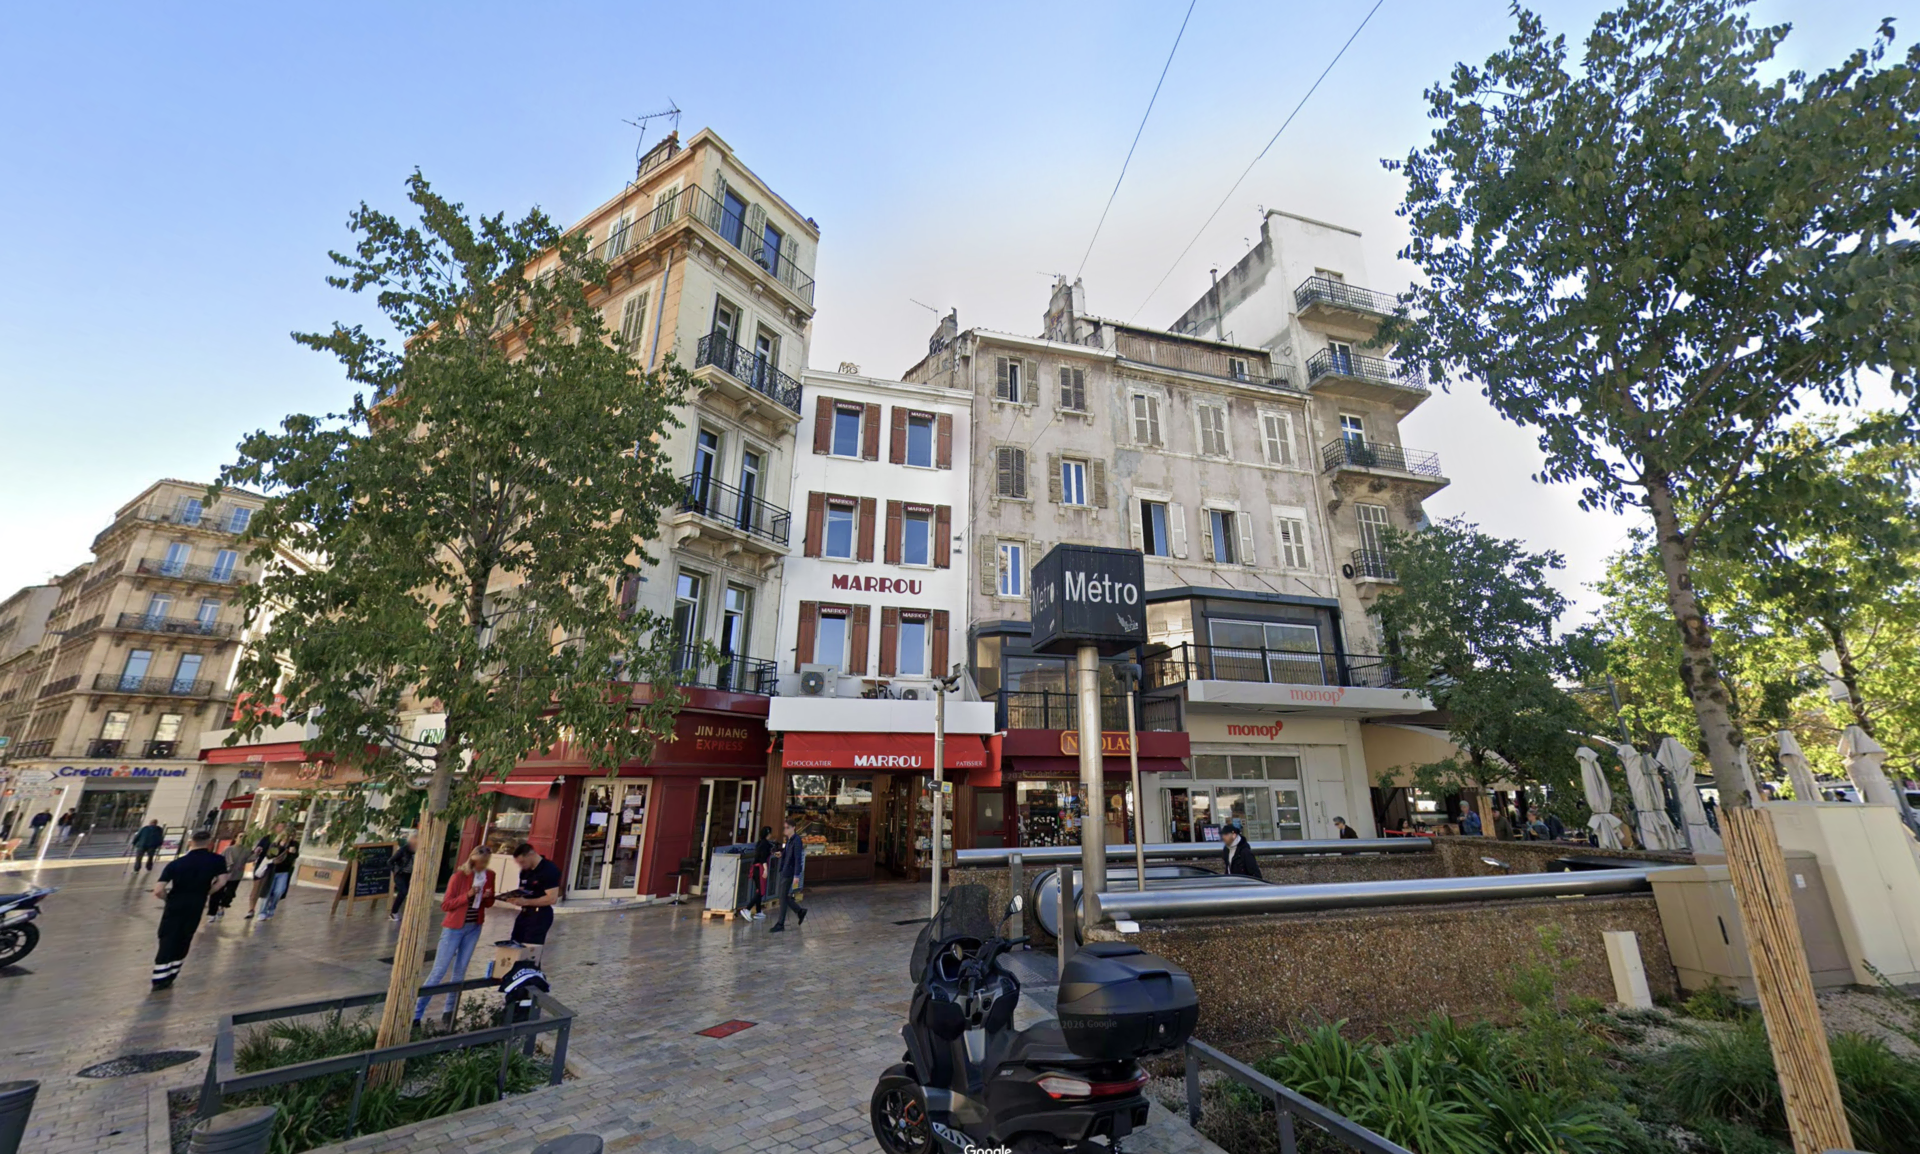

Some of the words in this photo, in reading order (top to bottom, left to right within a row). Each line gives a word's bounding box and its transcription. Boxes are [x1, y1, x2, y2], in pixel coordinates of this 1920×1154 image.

[906, 505, 932, 513] MARROU
[831, 573, 922, 595] MARROU
[1065, 570, 1138, 605] Métro
[821, 606, 848, 615] MARROU
[902, 611, 928, 619] MARROU
[695, 725, 713, 737] JIN
[715, 727, 748, 739] JIANG
[695, 738, 743, 751] EXPRESS
[786, 759, 832, 767] CHOCOLATIER
[853, 755, 922, 768] MARROU
[59, 766, 113, 777] Crédit
[131, 767, 188, 777] Mutuel
